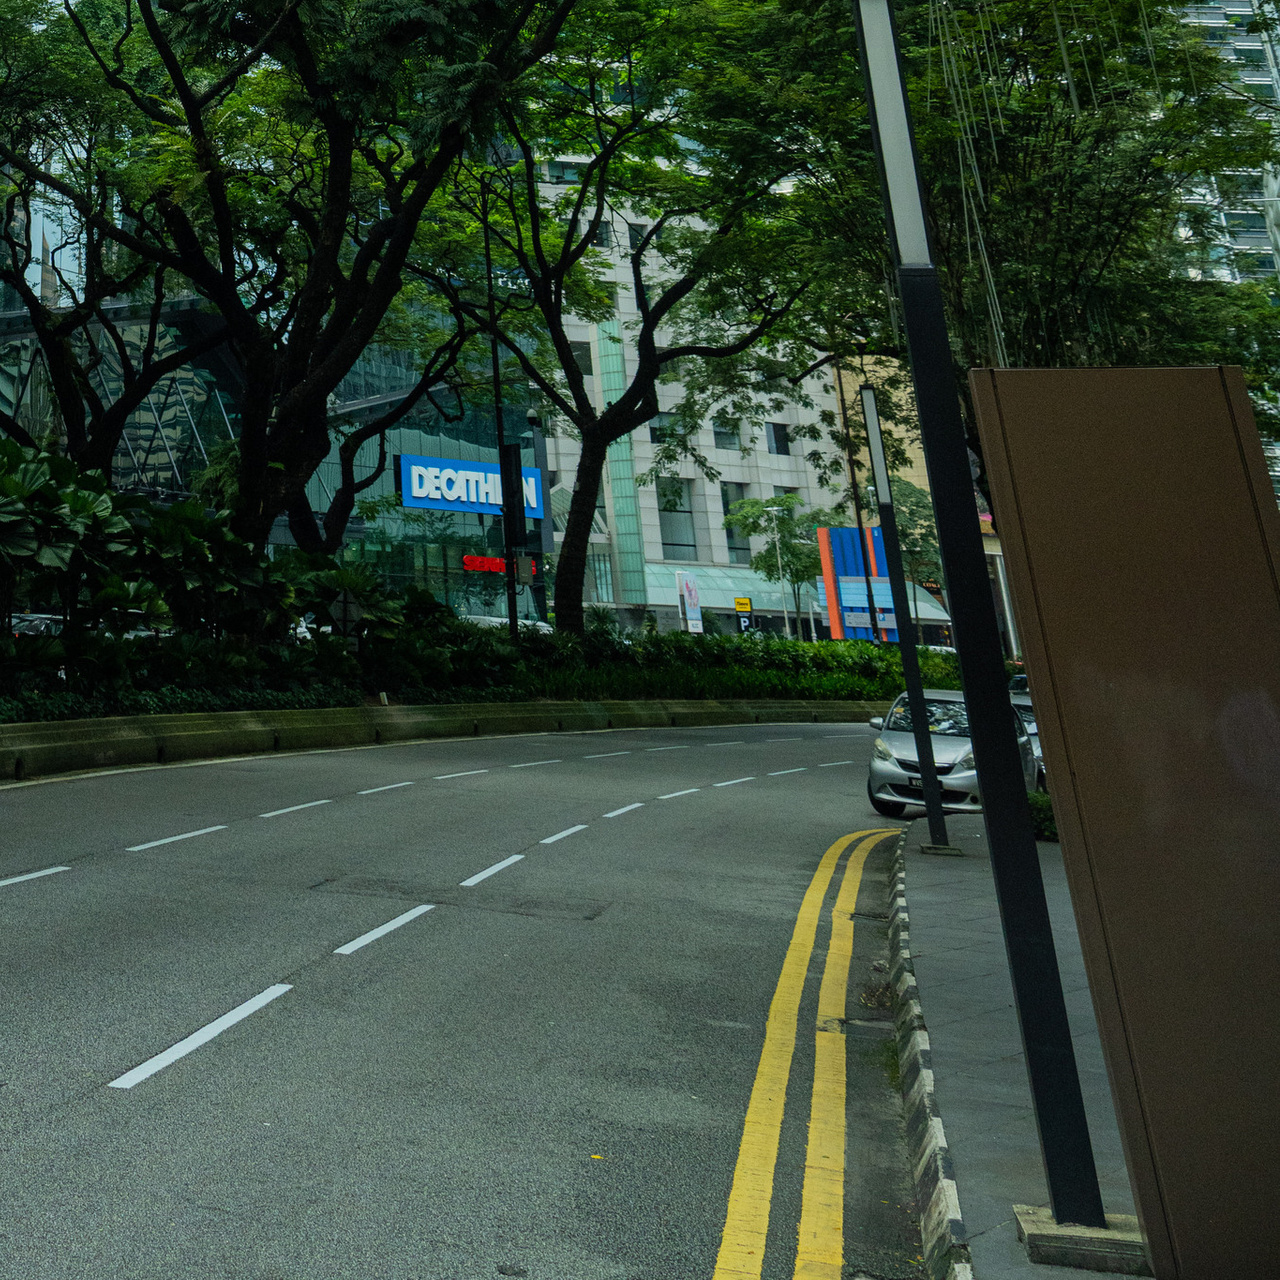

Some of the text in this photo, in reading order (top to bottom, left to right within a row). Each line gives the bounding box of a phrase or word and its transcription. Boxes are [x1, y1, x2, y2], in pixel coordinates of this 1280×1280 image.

[411, 465, 537, 508] DECATHLN
[463, 555, 536, 575] SENH
[740, 617, 750, 631] P
